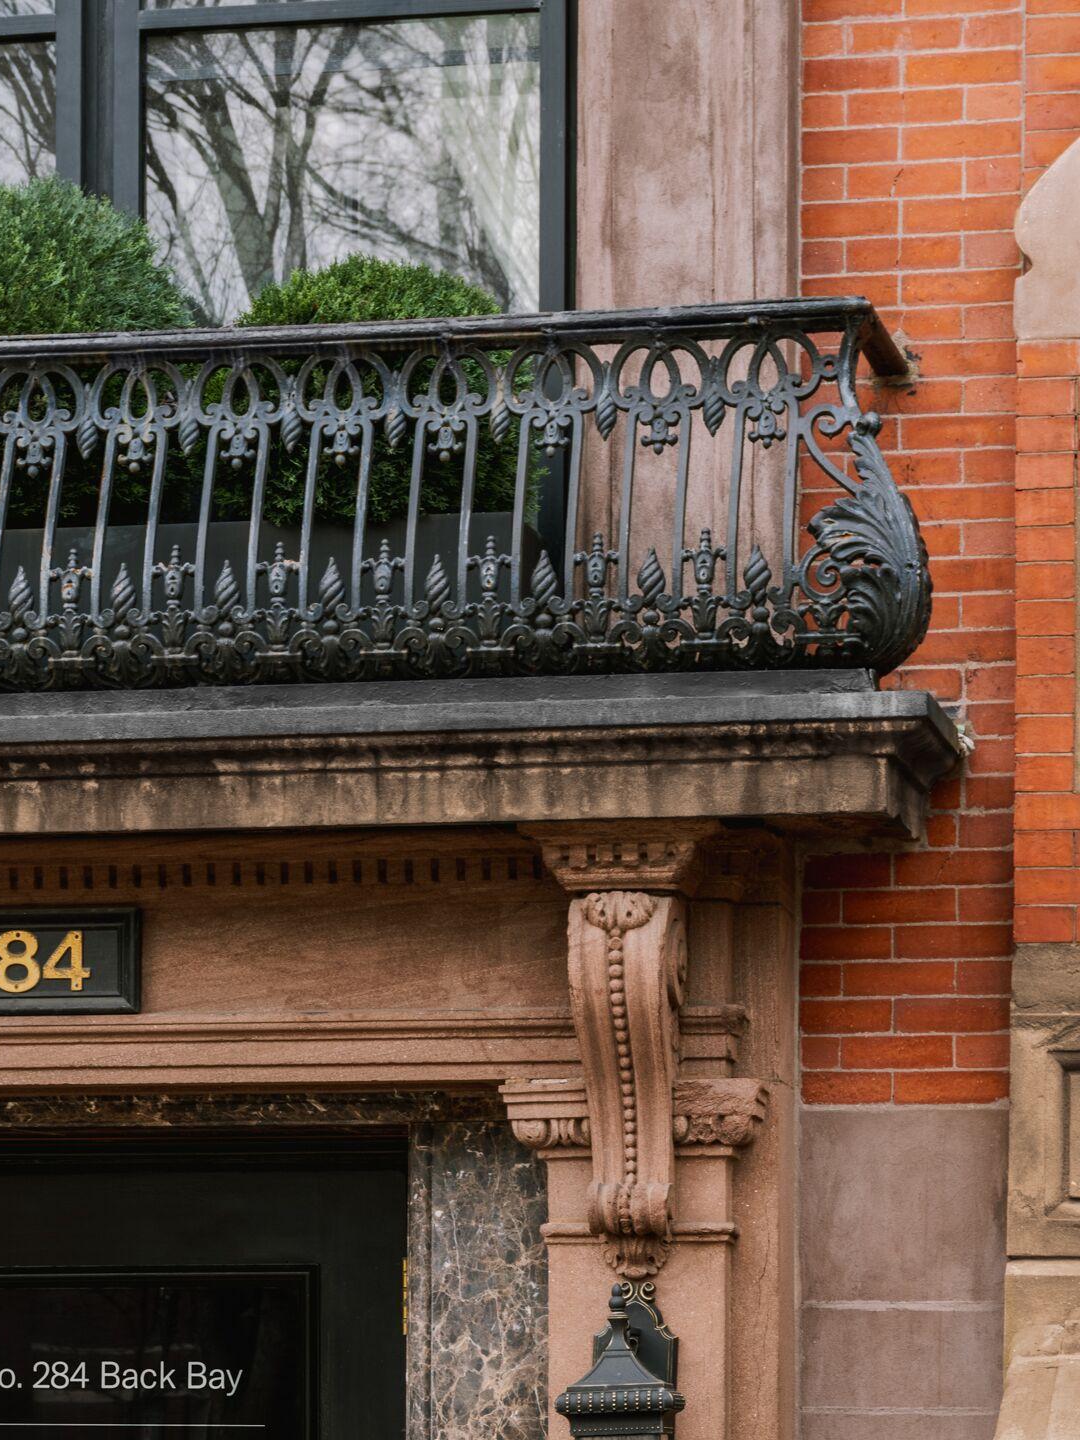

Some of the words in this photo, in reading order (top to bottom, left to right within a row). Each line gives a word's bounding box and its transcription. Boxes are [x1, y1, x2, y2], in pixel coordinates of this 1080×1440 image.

[32, 1360, 89, 1389] 284
[101, 1360, 177, 1389] Back
[187, 1361, 243, 1397] Bay
